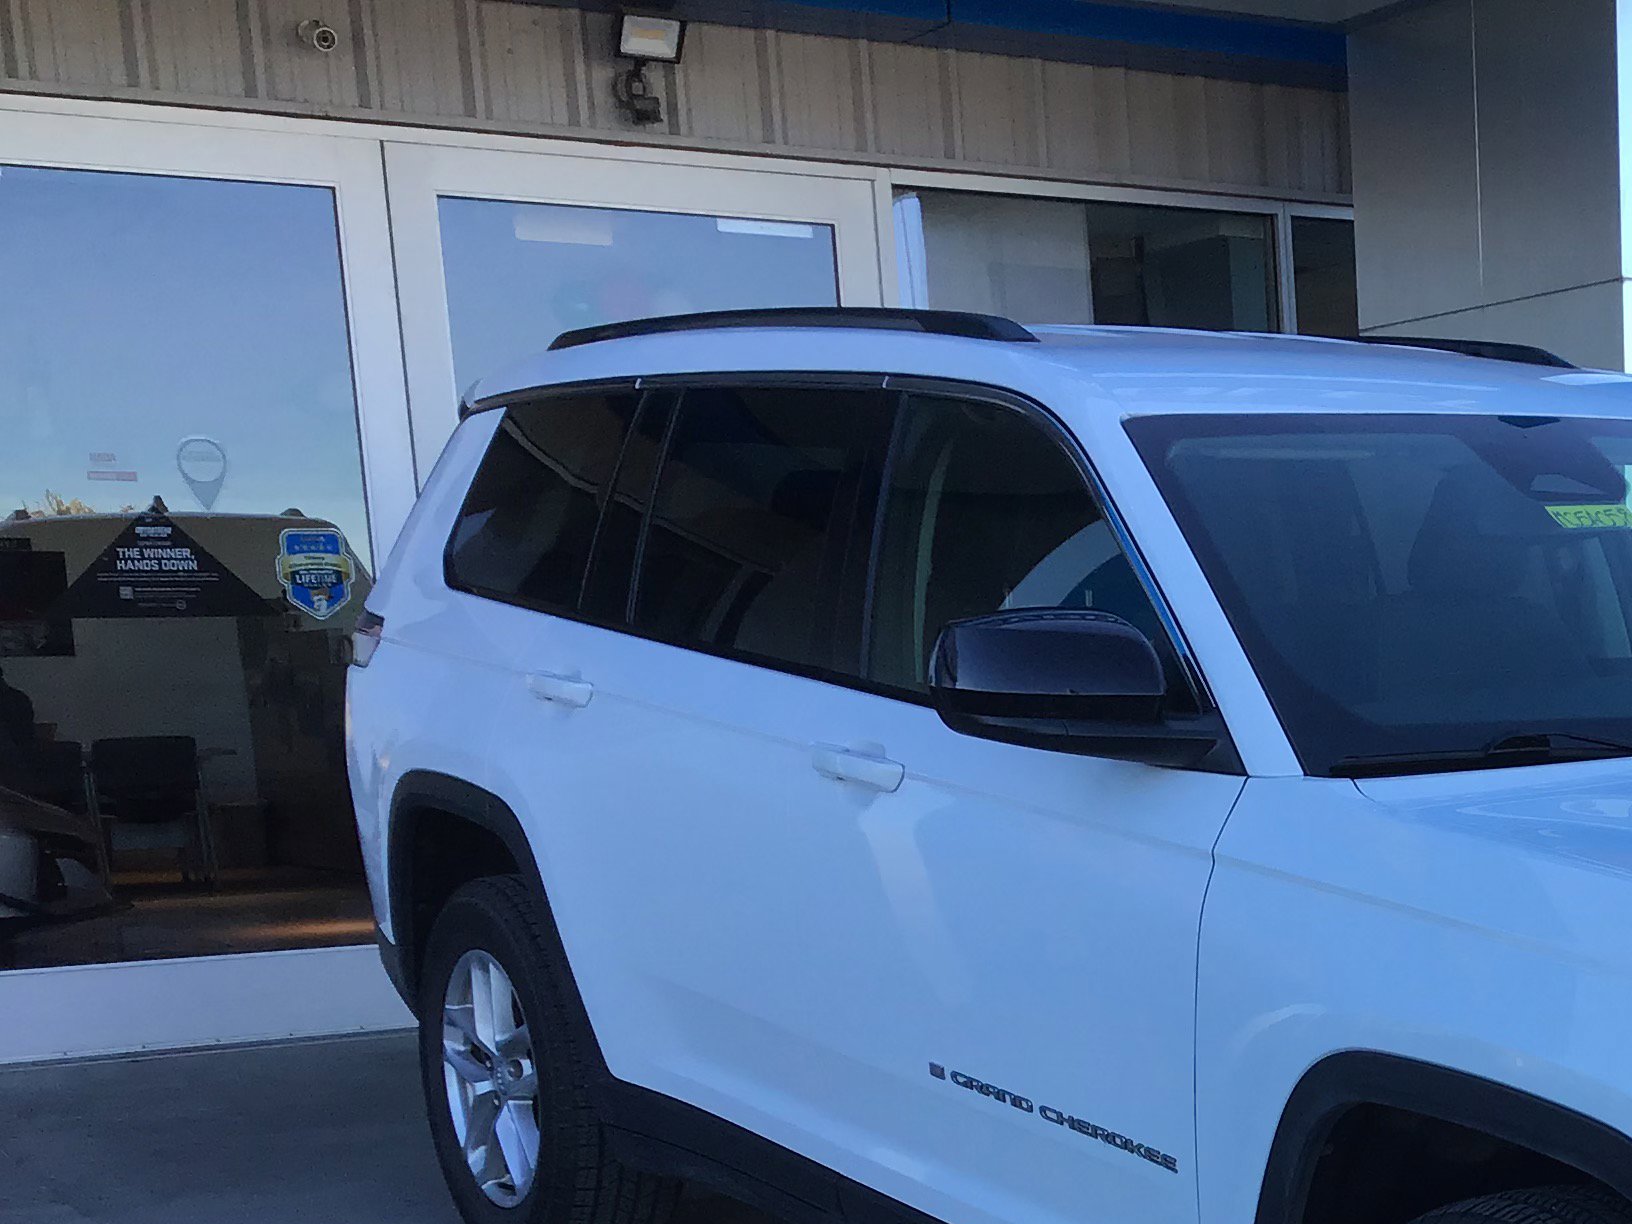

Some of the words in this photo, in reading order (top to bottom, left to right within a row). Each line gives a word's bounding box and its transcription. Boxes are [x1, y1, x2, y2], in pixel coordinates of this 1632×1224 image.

[116, 548, 142, 559] THE
[143, 548, 195, 560] WINNER,
[116, 560, 159, 570] HANDS
[161, 560, 198, 570] DOWN
[950, 1070, 1033, 1113] GRAND
[1039, 1105, 1178, 1174] CHEROKEE
